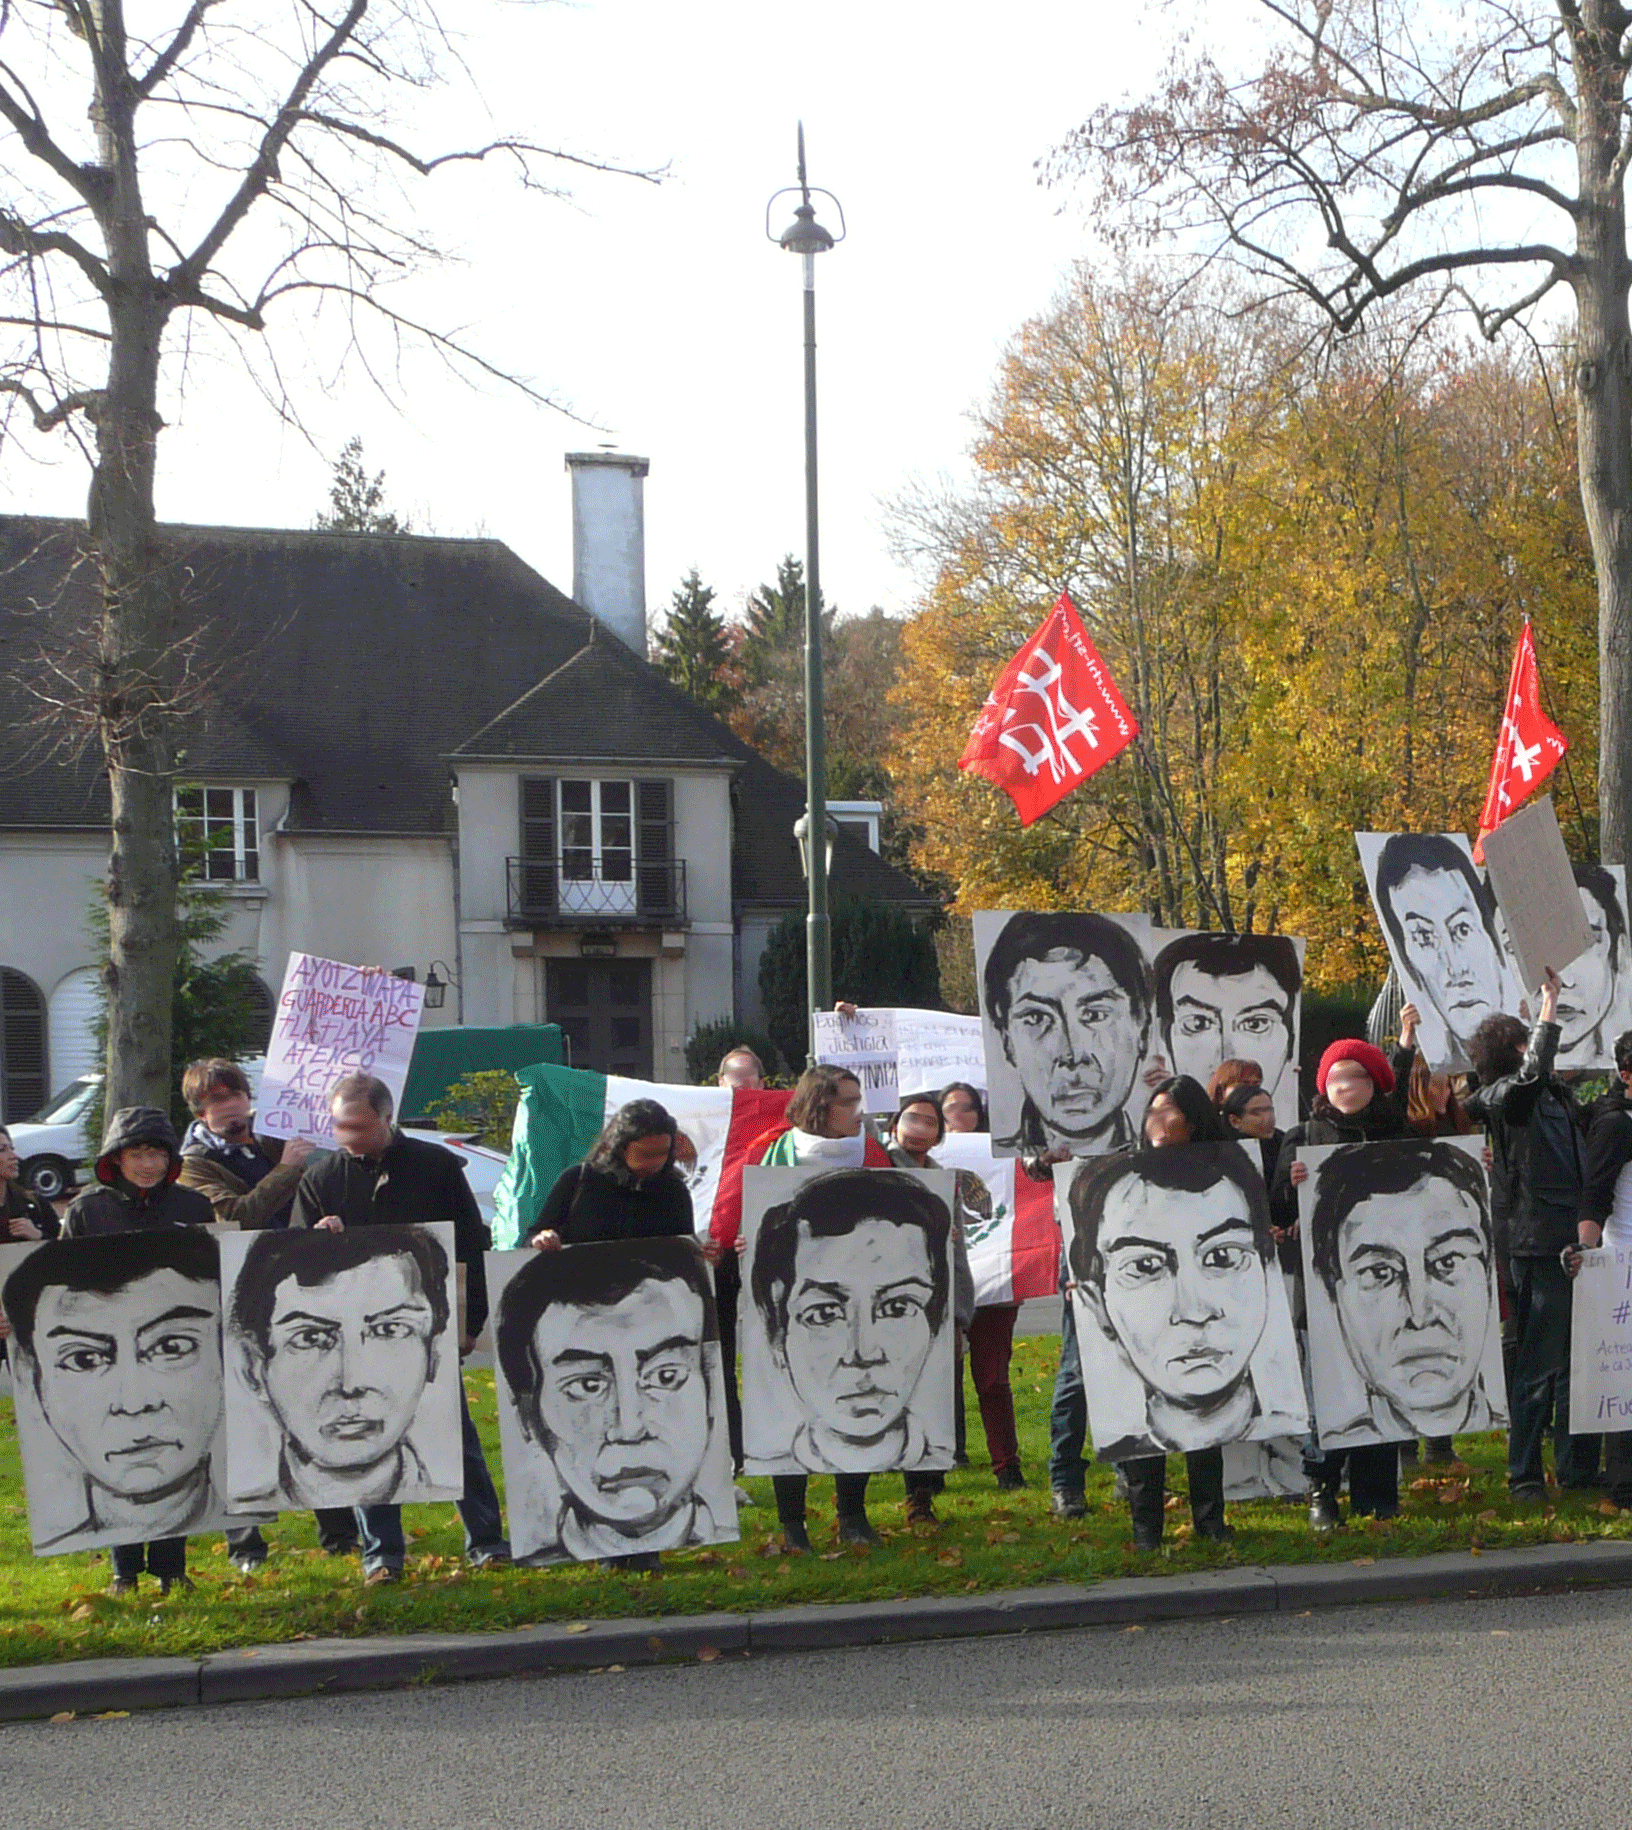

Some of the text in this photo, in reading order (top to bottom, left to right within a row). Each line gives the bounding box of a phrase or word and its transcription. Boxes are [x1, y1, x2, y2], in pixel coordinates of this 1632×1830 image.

[369, 999, 418, 1028] ABC
[279, 1014, 390, 1053] TLATLAYA
[282, 1041, 376, 1070] ATENCO
[297, 1112, 334, 1138] JUA
